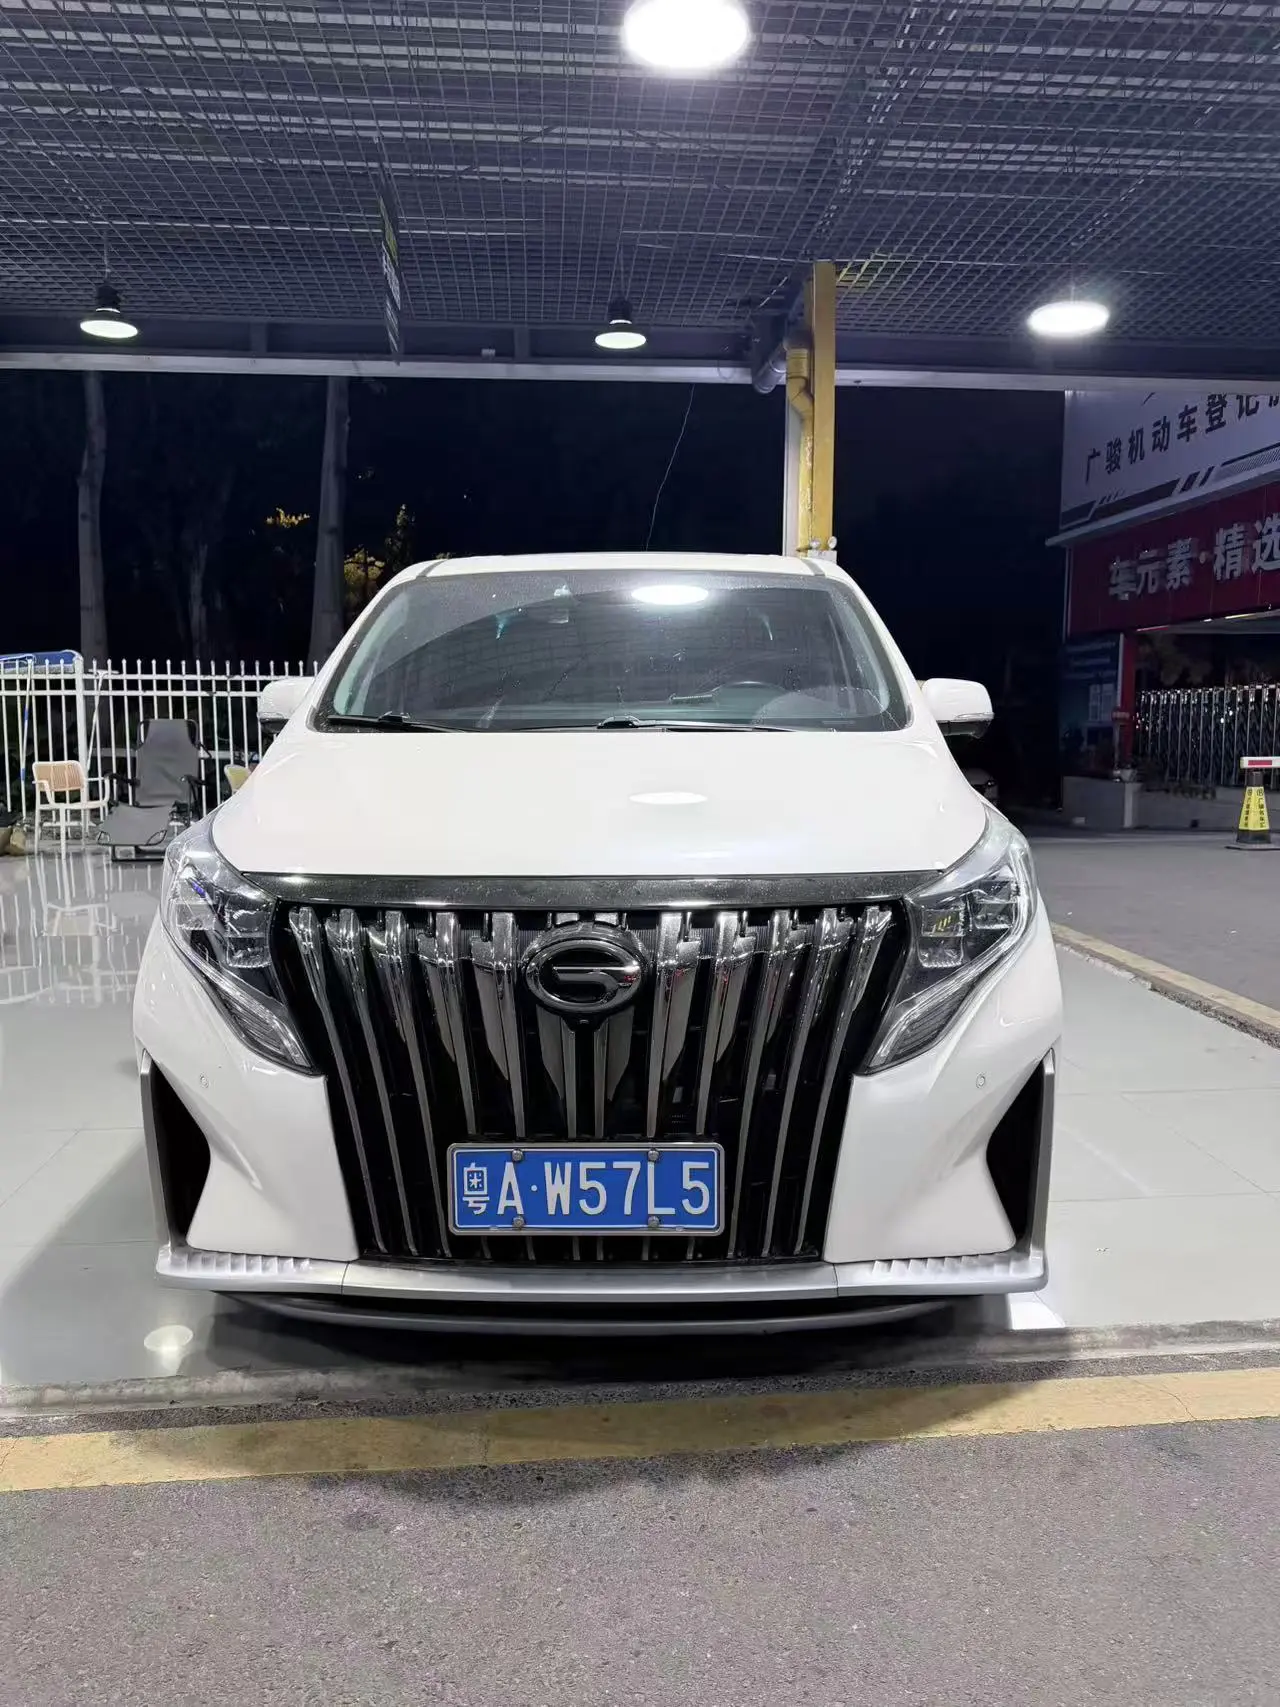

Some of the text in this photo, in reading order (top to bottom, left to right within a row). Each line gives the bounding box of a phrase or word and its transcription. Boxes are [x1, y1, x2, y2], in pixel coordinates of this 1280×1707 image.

[1085, 394, 1280, 484] 广骏机动车登记
[462, 1161, 710, 1216] 粤A·W57L5
